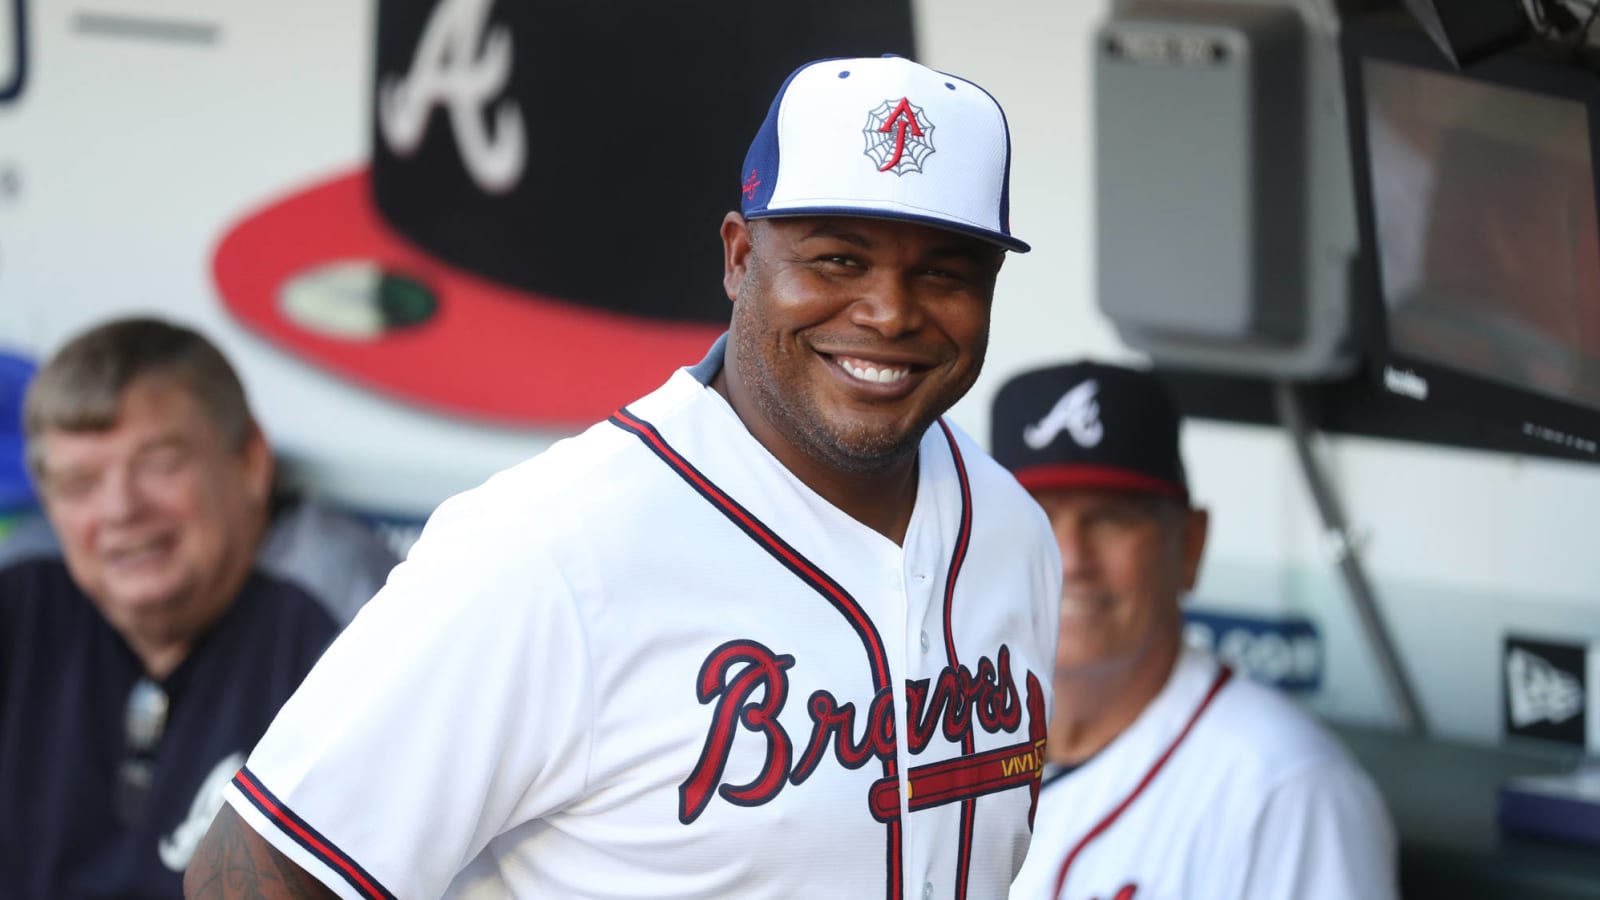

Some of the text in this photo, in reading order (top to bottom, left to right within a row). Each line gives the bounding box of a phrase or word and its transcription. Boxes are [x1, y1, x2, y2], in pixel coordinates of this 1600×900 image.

[379, 0, 528, 194] A
[1023, 378, 1103, 450] A
[678, 638, 1022, 826] Braves
